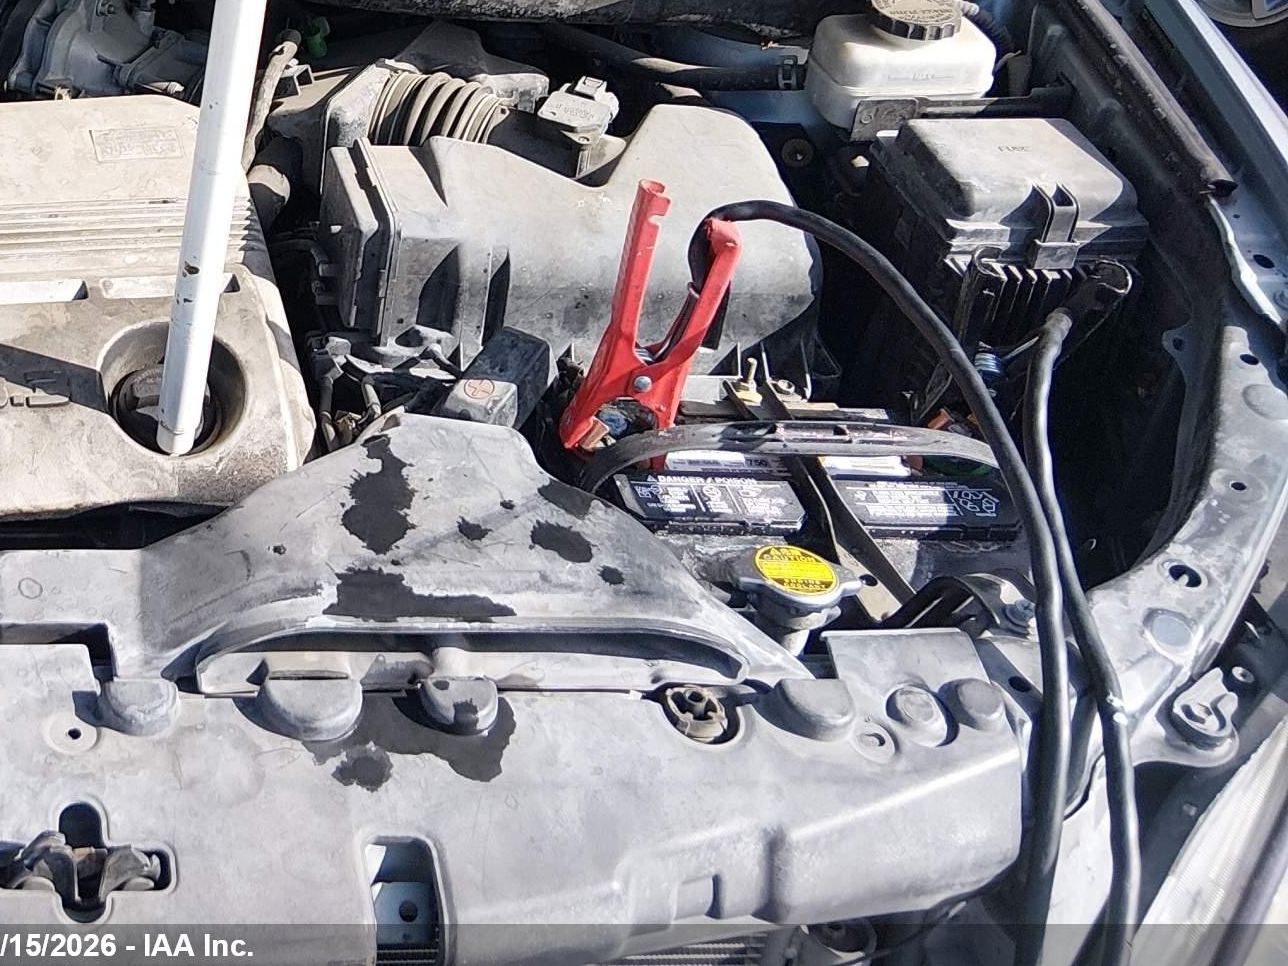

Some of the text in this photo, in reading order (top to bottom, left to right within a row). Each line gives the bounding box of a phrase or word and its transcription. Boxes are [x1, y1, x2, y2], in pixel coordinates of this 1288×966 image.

[746, 458, 768, 467] 750
[657, 475, 705, 484] DANGER
[714, 476, 758, 485] POISON
[762, 553, 816, 563] CAUTION
